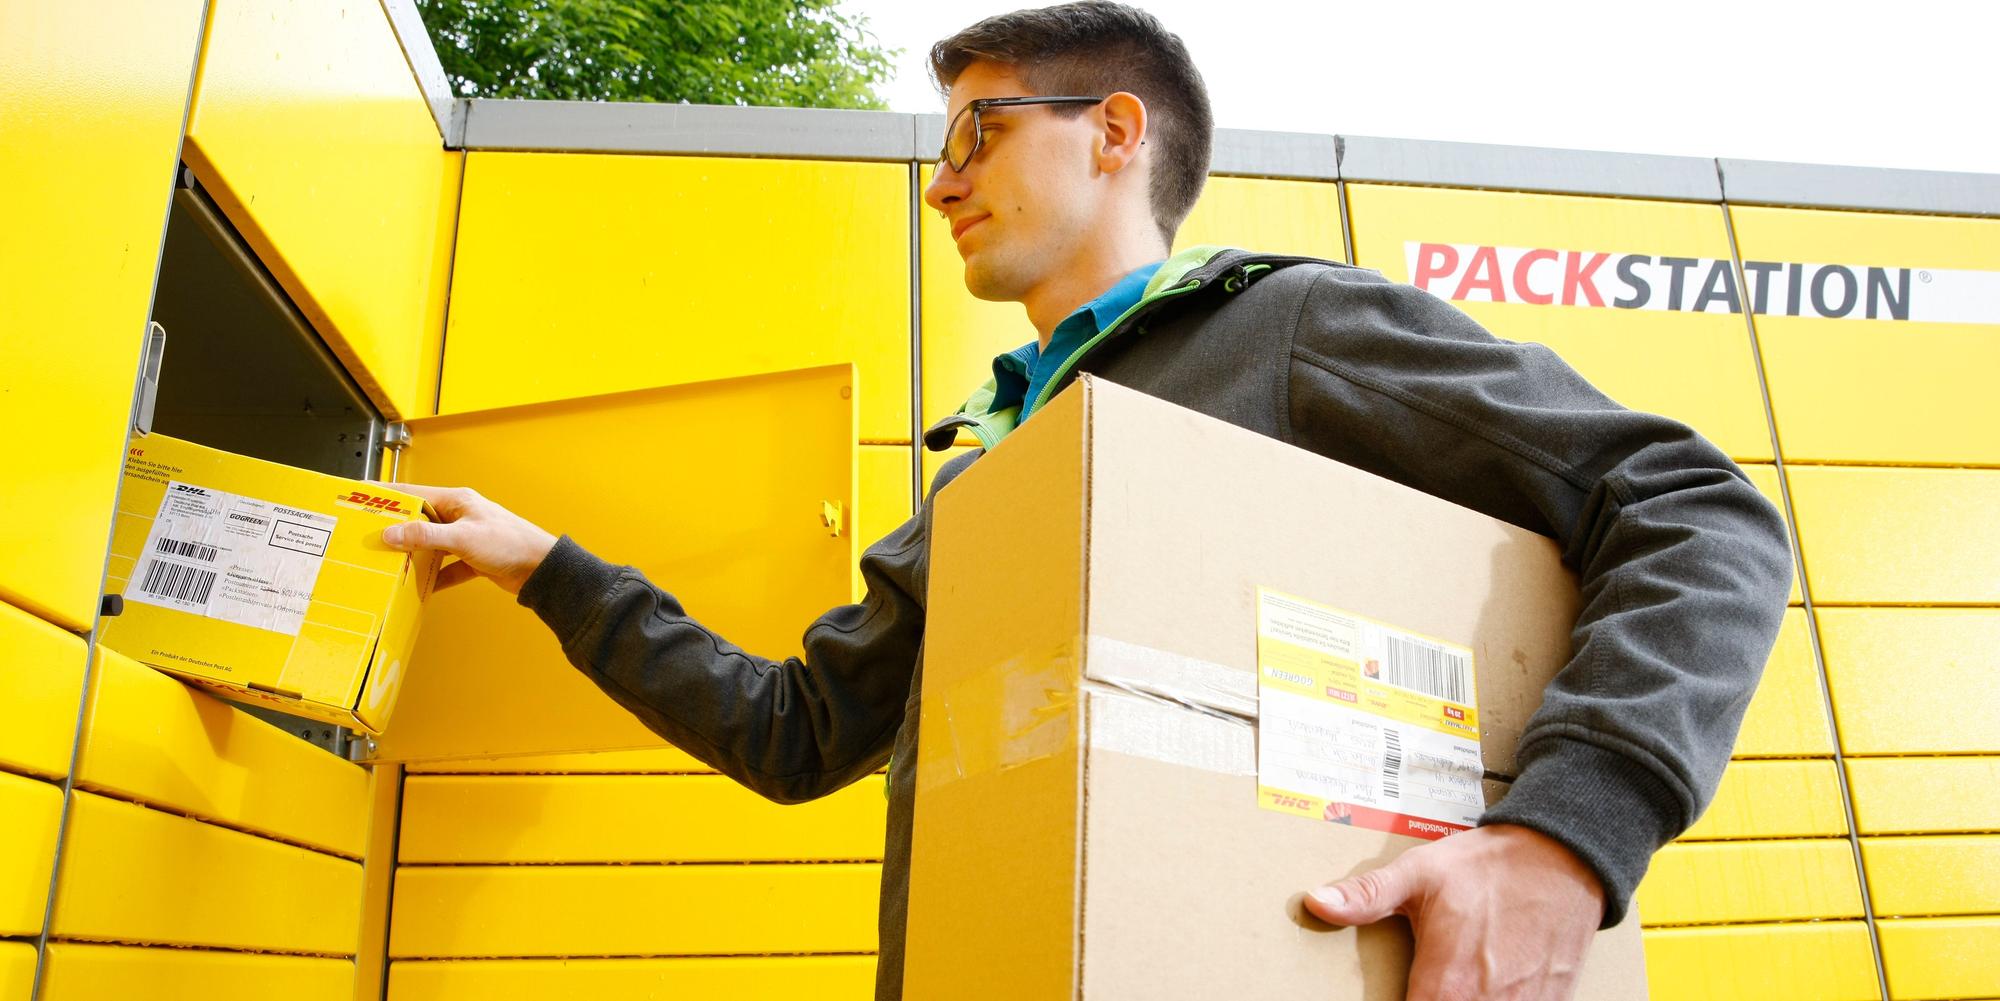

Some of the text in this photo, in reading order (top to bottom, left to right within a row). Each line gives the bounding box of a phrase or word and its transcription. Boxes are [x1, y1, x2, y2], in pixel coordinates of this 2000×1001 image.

[1413, 242, 1911, 320] PACKSTATION
[128, 456, 147, 465] Kleben
[157, 462, 170, 471] bitte
[175, 485, 207, 496] DHL
[347, 491, 401, 512] DHL
[229, 513, 264, 525] GOGREEN
[273, 507, 313, 520] POSTSACHE
[276, 534, 294, 542] Service
[288, 530, 314, 540] Postsache
[160, 652, 179, 660] Produkt
[188, 658, 214, 668] Deutschen
[1271, 668, 1313, 686] GOGREEN
[1446, 707, 1454, 716] kg
[1272, 794, 1311, 811] DHL
[1408, 820, 1448, 836] Deutschland
